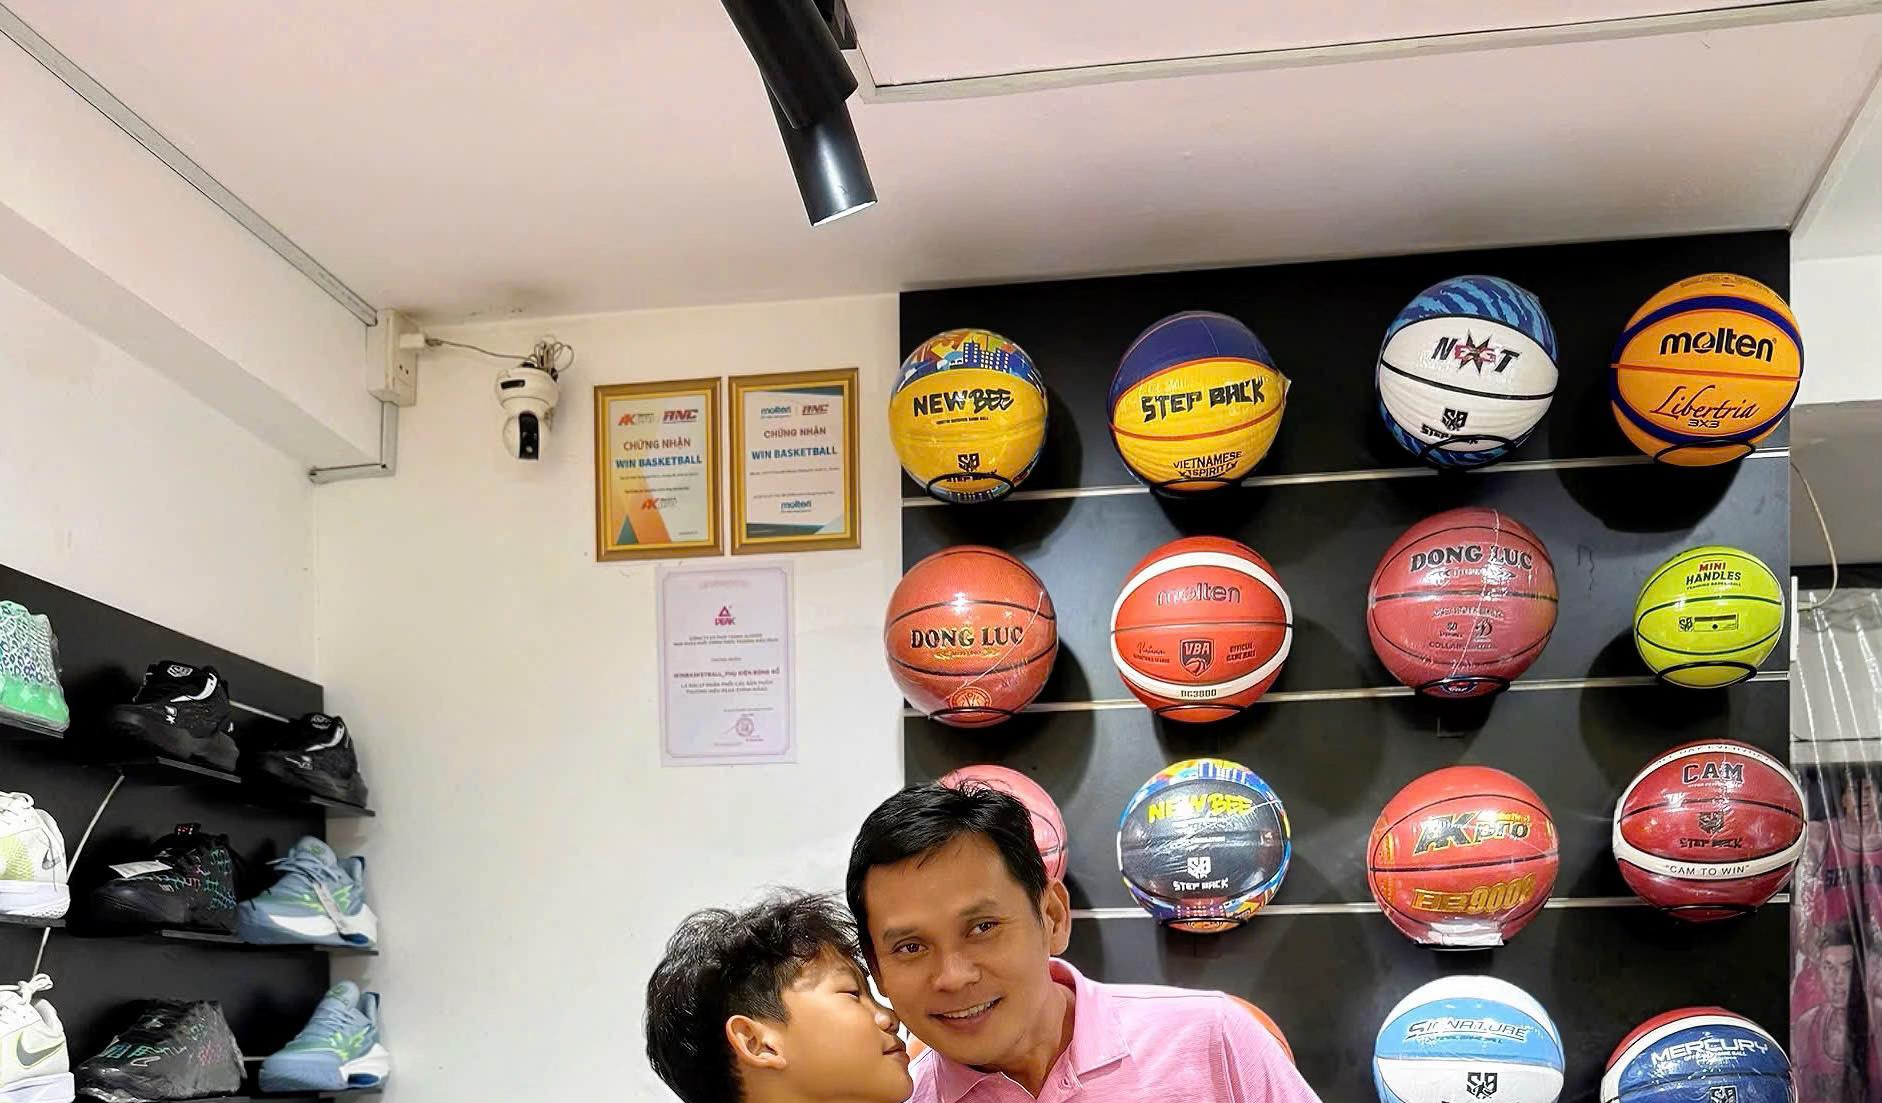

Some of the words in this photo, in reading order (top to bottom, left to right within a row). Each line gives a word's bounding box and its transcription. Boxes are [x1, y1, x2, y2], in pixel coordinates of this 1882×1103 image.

[1660, 327, 1744, 362] molten
[1141, 391, 1202, 423] STEP
[1209, 376, 1264, 408] BACK
[1650, 385, 1760, 420] Libertria
[623, 438, 659, 451] CHỨNG
[662, 437, 691, 449] NHẬN
[751, 449, 772, 460] WIN
[774, 445, 838, 459] BASKETBALL
[615, 458, 636, 468] WIN
[638, 455, 703, 468] BASKETBALL
[1173, 451, 1243, 469] VIETNAMESE
[1410, 546, 1483, 572] DONG
[1489, 545, 1533, 571] LUC
[1698, 561, 1727, 573] MINI
[1686, 570, 1742, 586] HANDLES
[1157, 583, 1242, 607] molten
[910, 626, 975, 650] DONG
[981, 626, 1024, 647] LUC
[1184, 640, 1211, 656] VBA
[1682, 762, 1745, 785] CAM
[1702, 867, 1718, 876] TO
[1650, 1037, 1769, 1067] MERCURY
